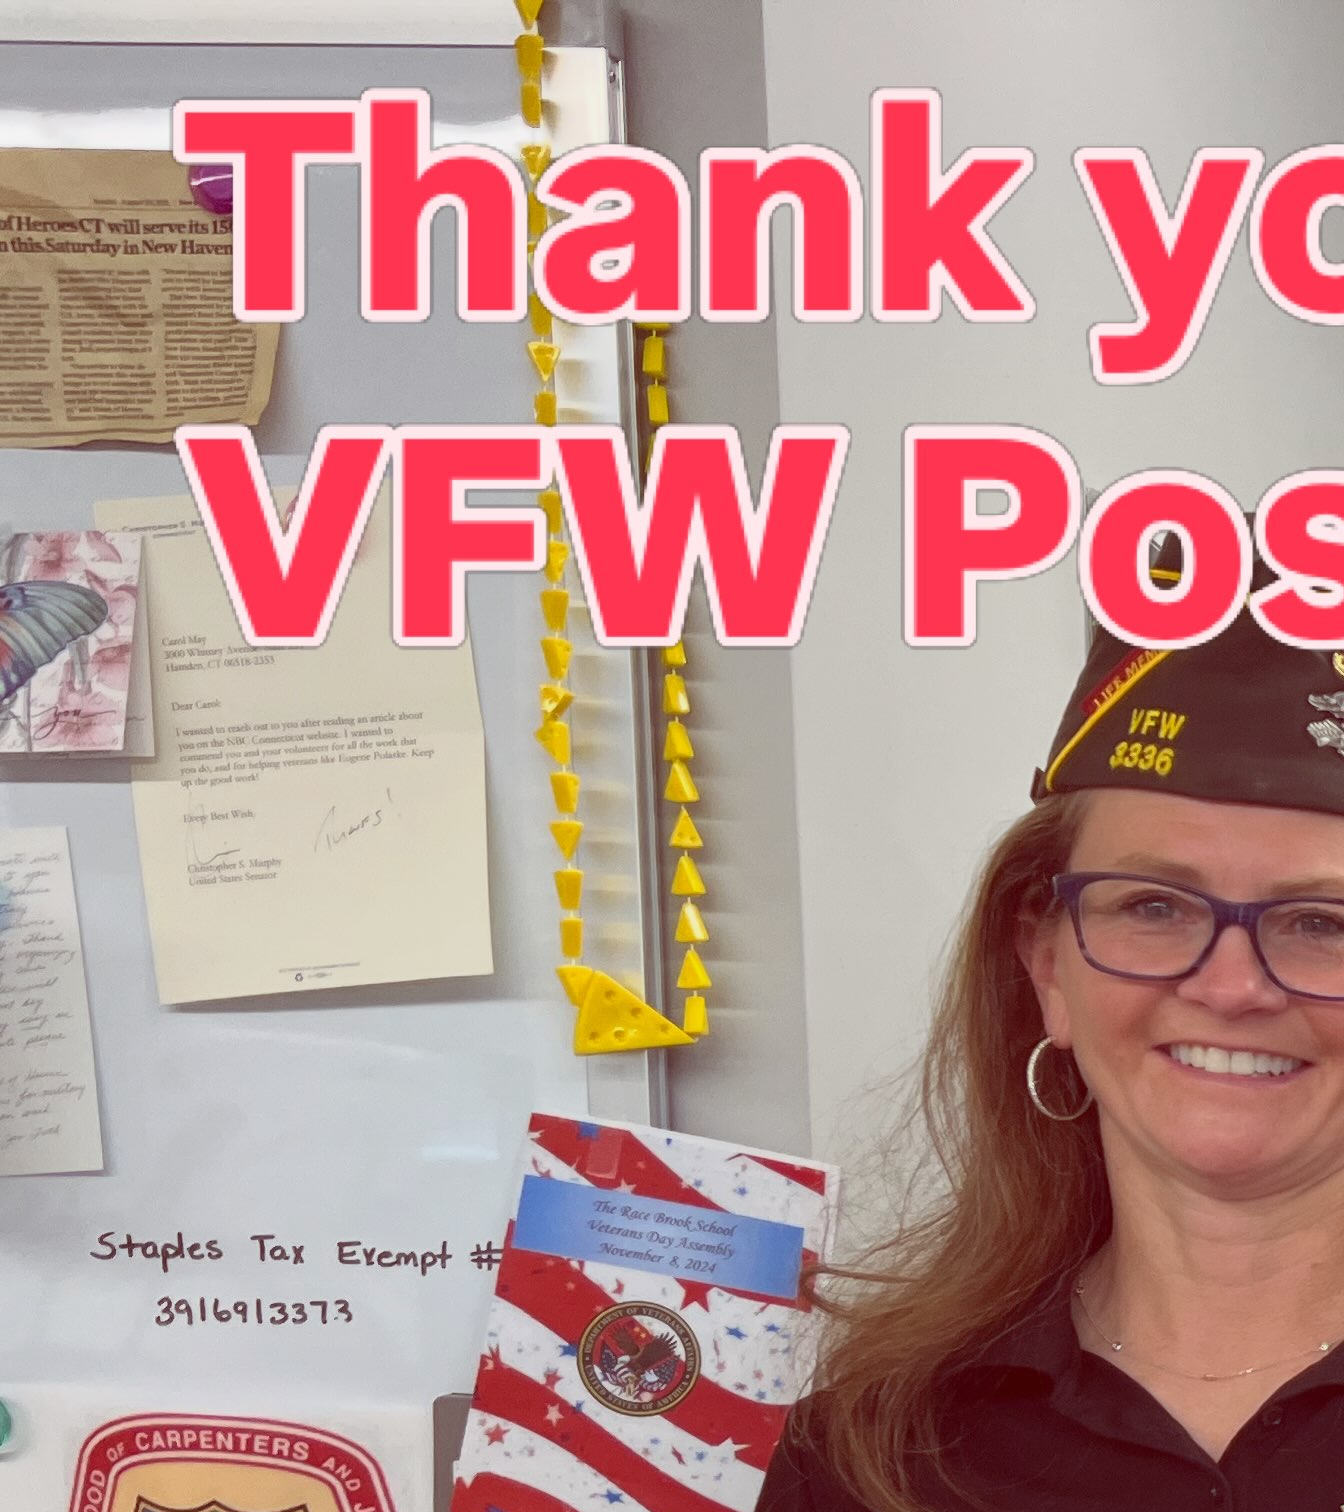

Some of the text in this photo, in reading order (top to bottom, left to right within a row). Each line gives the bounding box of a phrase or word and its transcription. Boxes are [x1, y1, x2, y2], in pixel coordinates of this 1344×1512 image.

[17, 216, 79, 232] Heroes
[80, 218, 105, 233] CT
[108, 219, 140, 234] will
[143, 222, 186, 234] serve
[188, 220, 208, 234] its
[11, 237, 44, 252] this
[46, 238, 120, 257] Saturday
[123, 240, 139, 254] in
[141, 240, 177, 254] New
[181, 240, 233, 255] Haven
[171, 701, 193, 712] Dear
[1128, 708, 1186, 740] VFW
[1109, 741, 1175, 777] 3336
[593, 1199, 738, 1237] The Race Brook School
[90, 1232, 223, 1273] Staples
[250, 1235, 304, 1264] Tax
[337, 1241, 452, 1276] Exempt
[587, 1219, 736, 1259] Veterans Day Assembly
[599, 1242, 717, 1274] November 8, 2024
[156, 1297, 352, 1326] 3916913373
[106, 1442, 126, 1462] OF
[135, 1430, 310, 1462] CARPENTERS
[321, 1456, 361, 1493] AND
